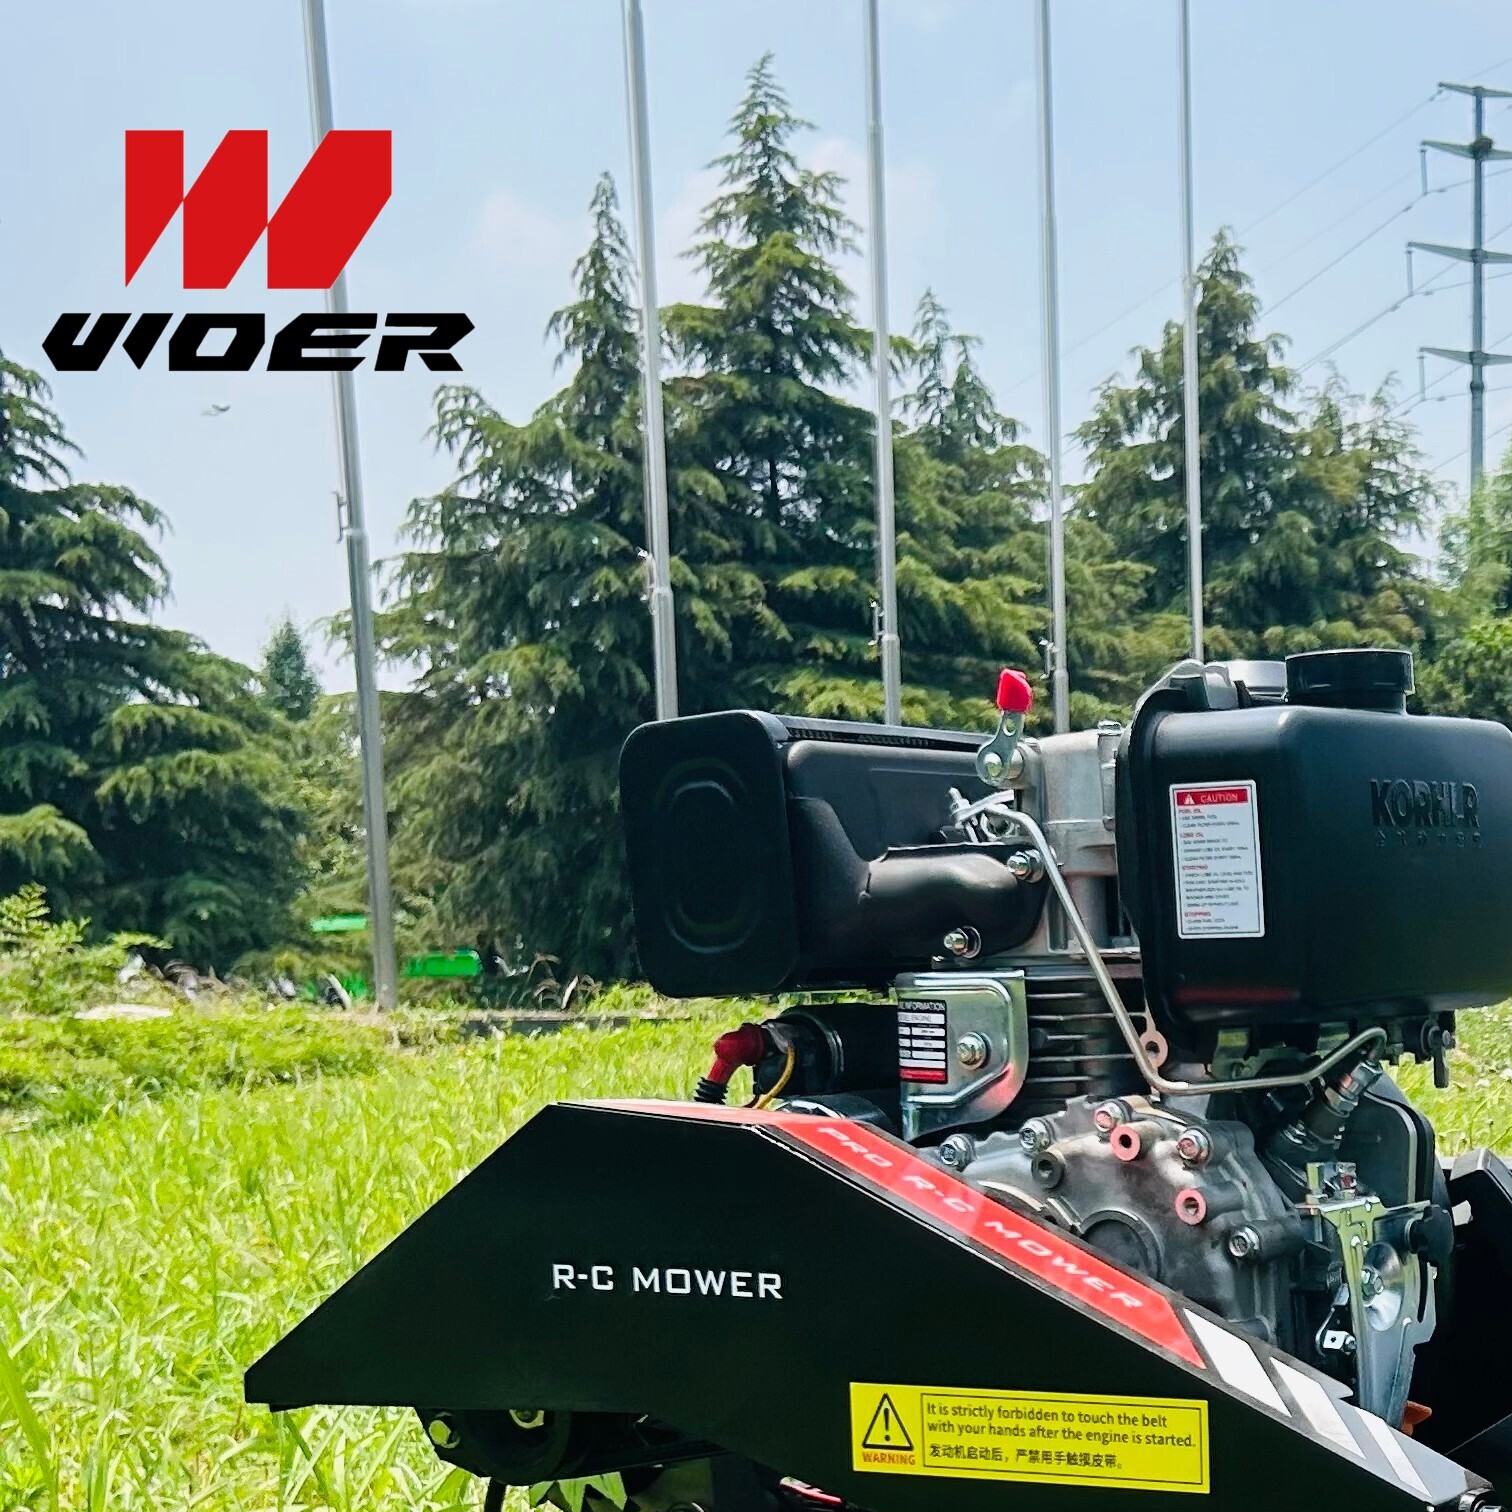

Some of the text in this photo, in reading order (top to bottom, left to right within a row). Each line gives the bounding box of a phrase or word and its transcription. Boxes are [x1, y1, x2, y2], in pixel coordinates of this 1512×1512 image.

[1200, 793, 1238, 804] CAUTION
[817, 1127, 1144, 1308] PRO R-C MOWER
[552, 1263, 783, 1300] R-C MOWER
[927, 1403, 1168, 1428] It is strictly forbidden to touch the belt
[927, 1420, 1196, 1448] with your hands after the engine is started.
[862, 1452, 916, 1465] WARNING
